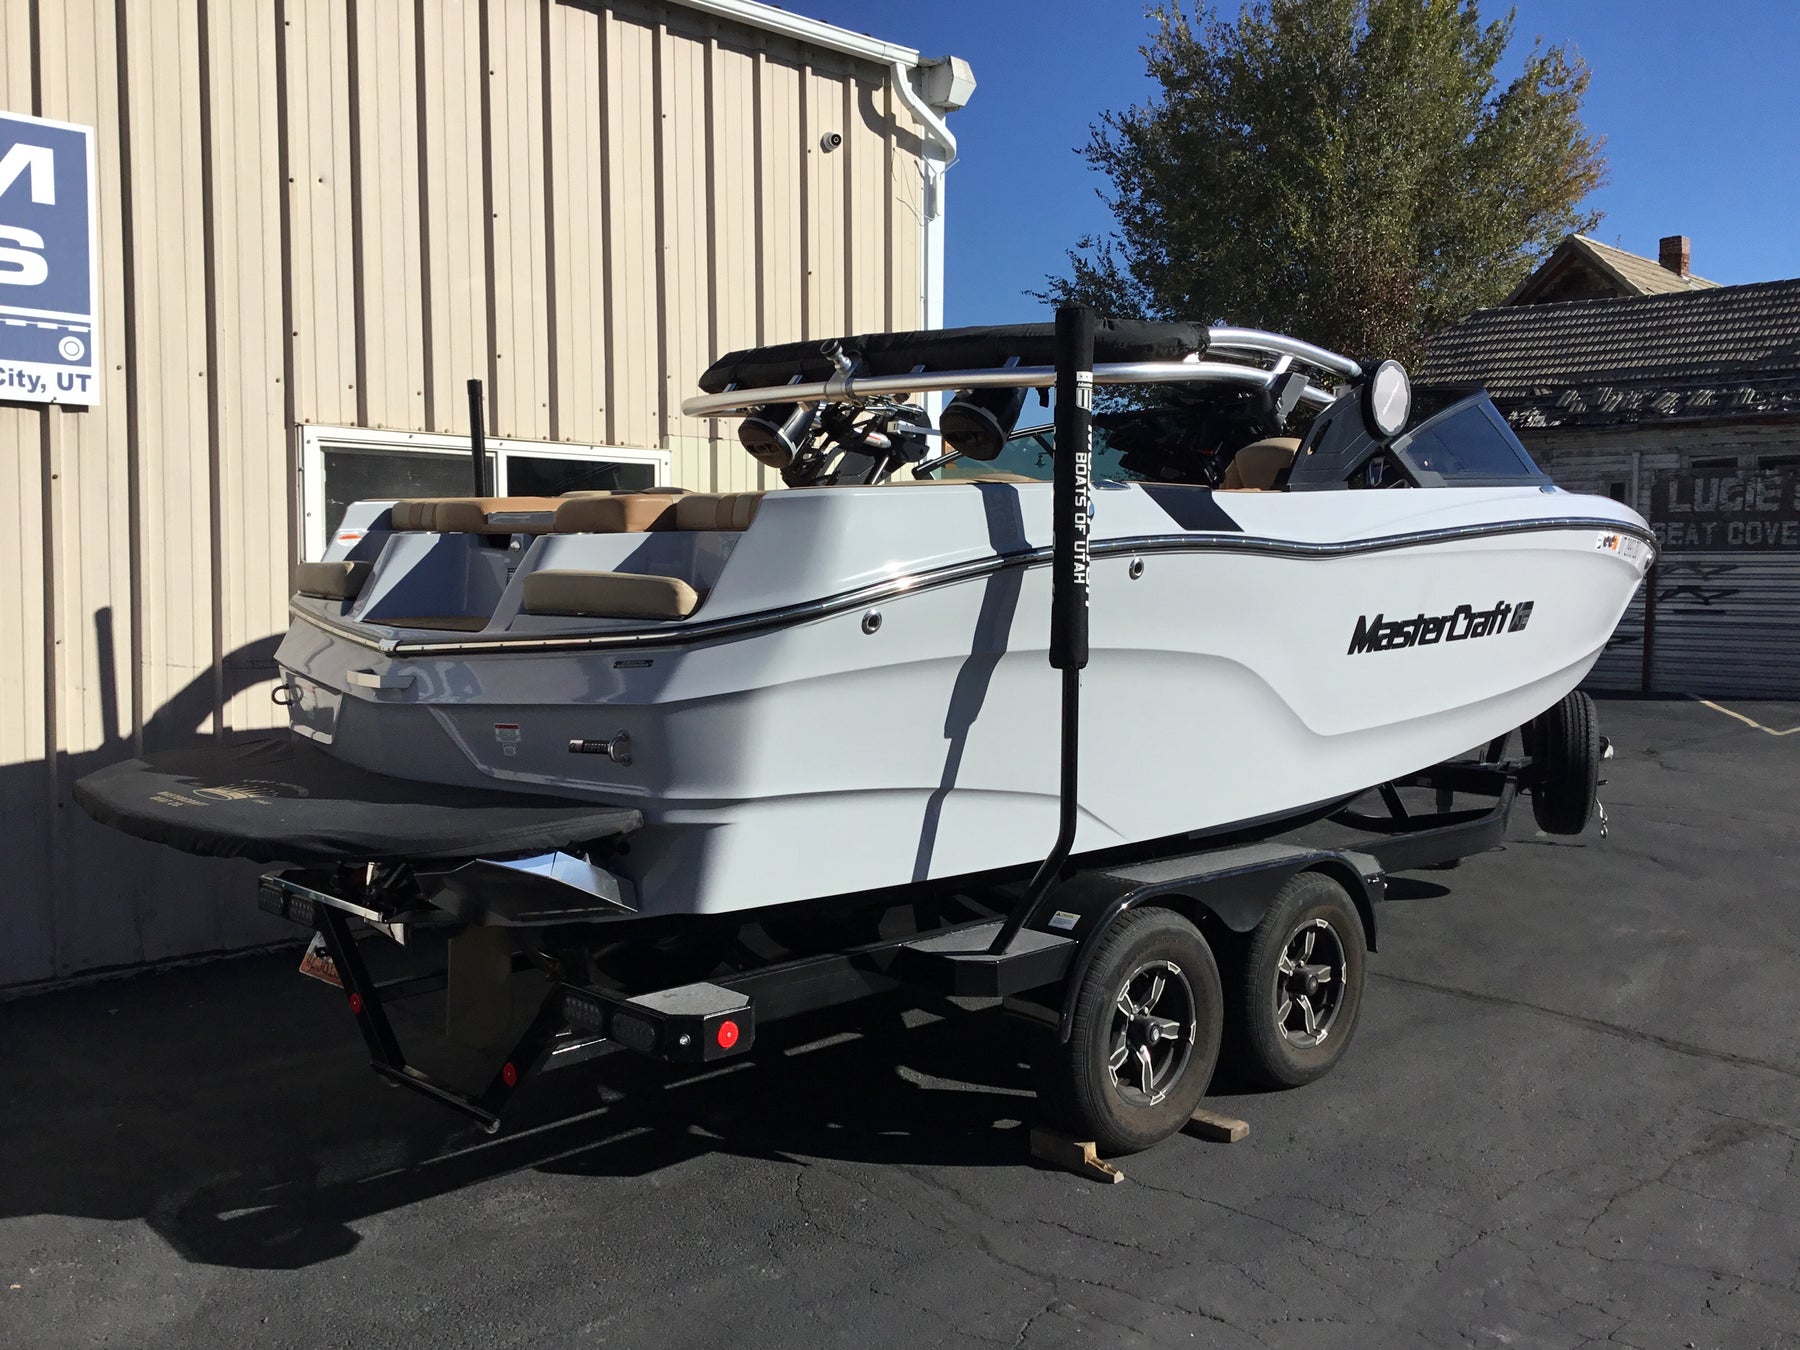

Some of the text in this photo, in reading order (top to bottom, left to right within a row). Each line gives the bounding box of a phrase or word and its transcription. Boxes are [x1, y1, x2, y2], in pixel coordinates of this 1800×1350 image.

[57, 372, 91, 392] UT
[1073, 452, 1088, 584] BOATS OF UTAH
[1652, 521, 1717, 545] SEAT
[1347, 600, 1512, 655] MasterCraft
